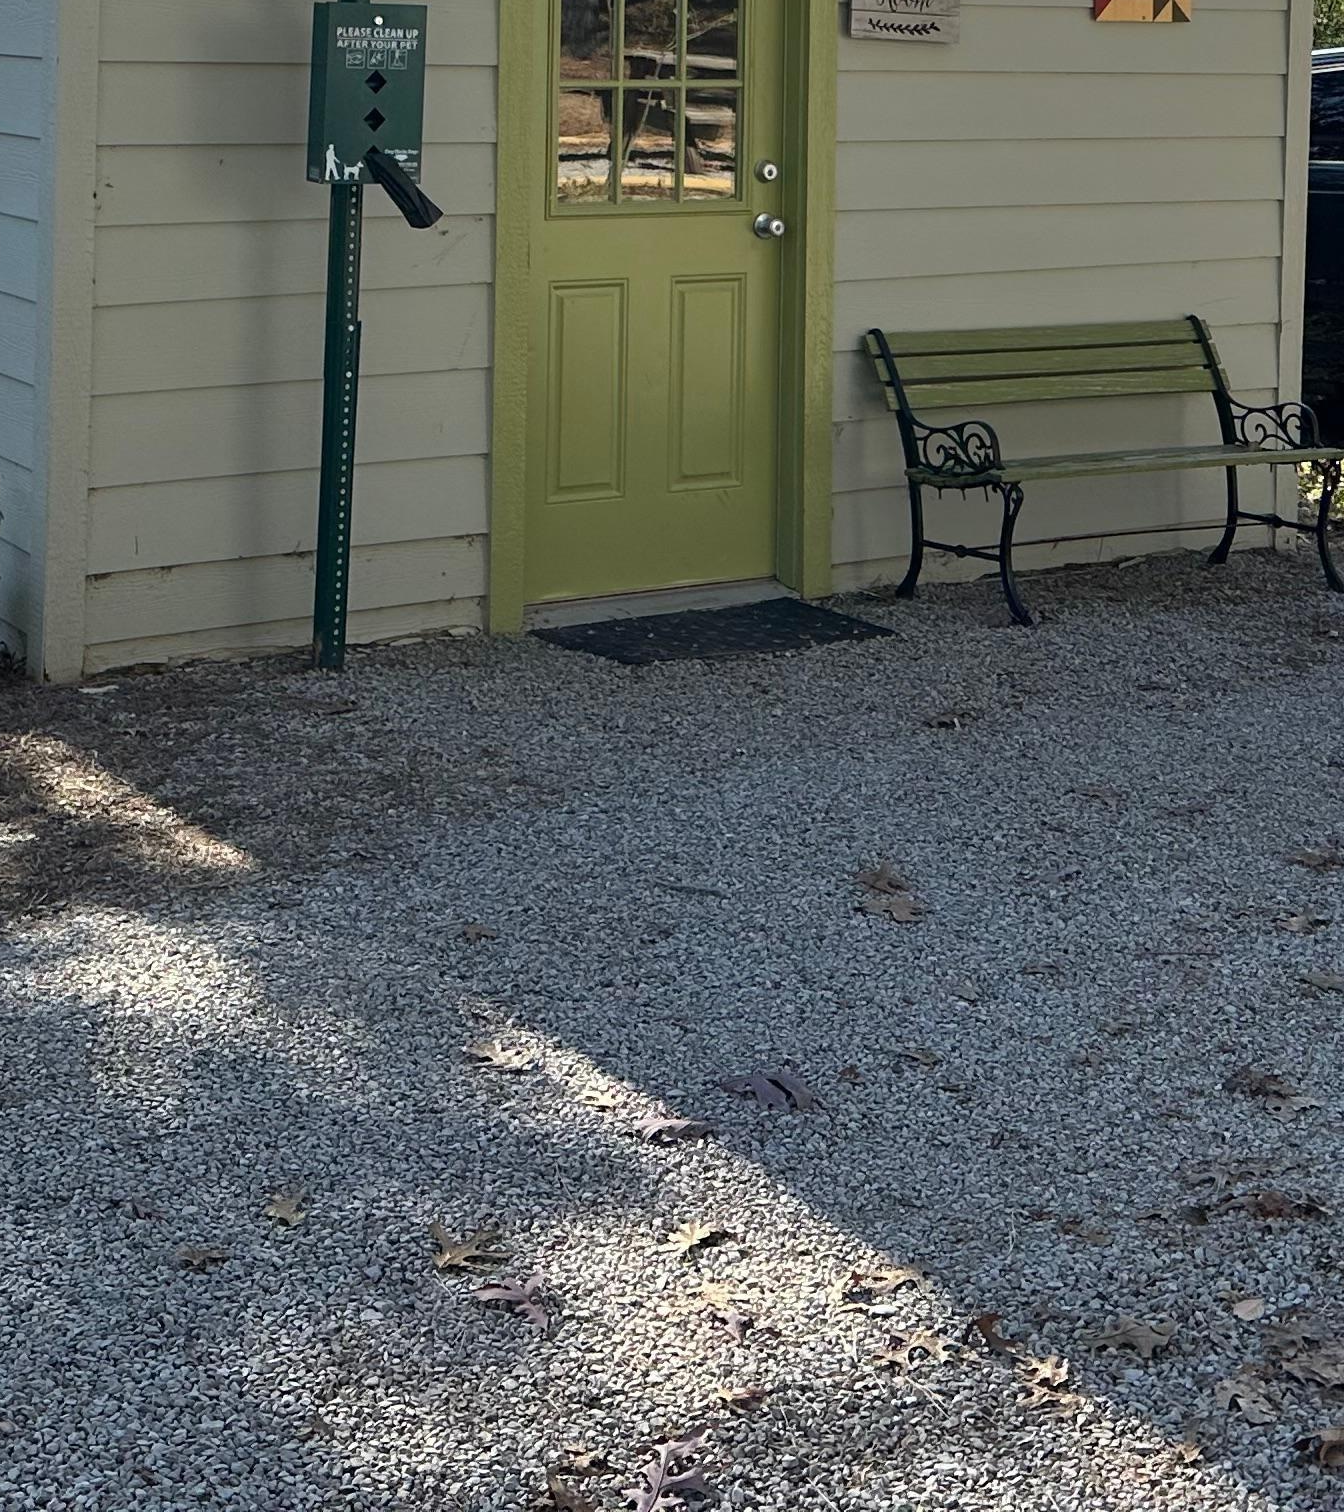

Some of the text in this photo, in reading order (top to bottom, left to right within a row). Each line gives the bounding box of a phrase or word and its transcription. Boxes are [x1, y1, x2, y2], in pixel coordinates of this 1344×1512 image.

[336, 27, 419, 39] PLEASE CLEAN UP
[336, 39, 418, 50] AFTER YOUR PET
